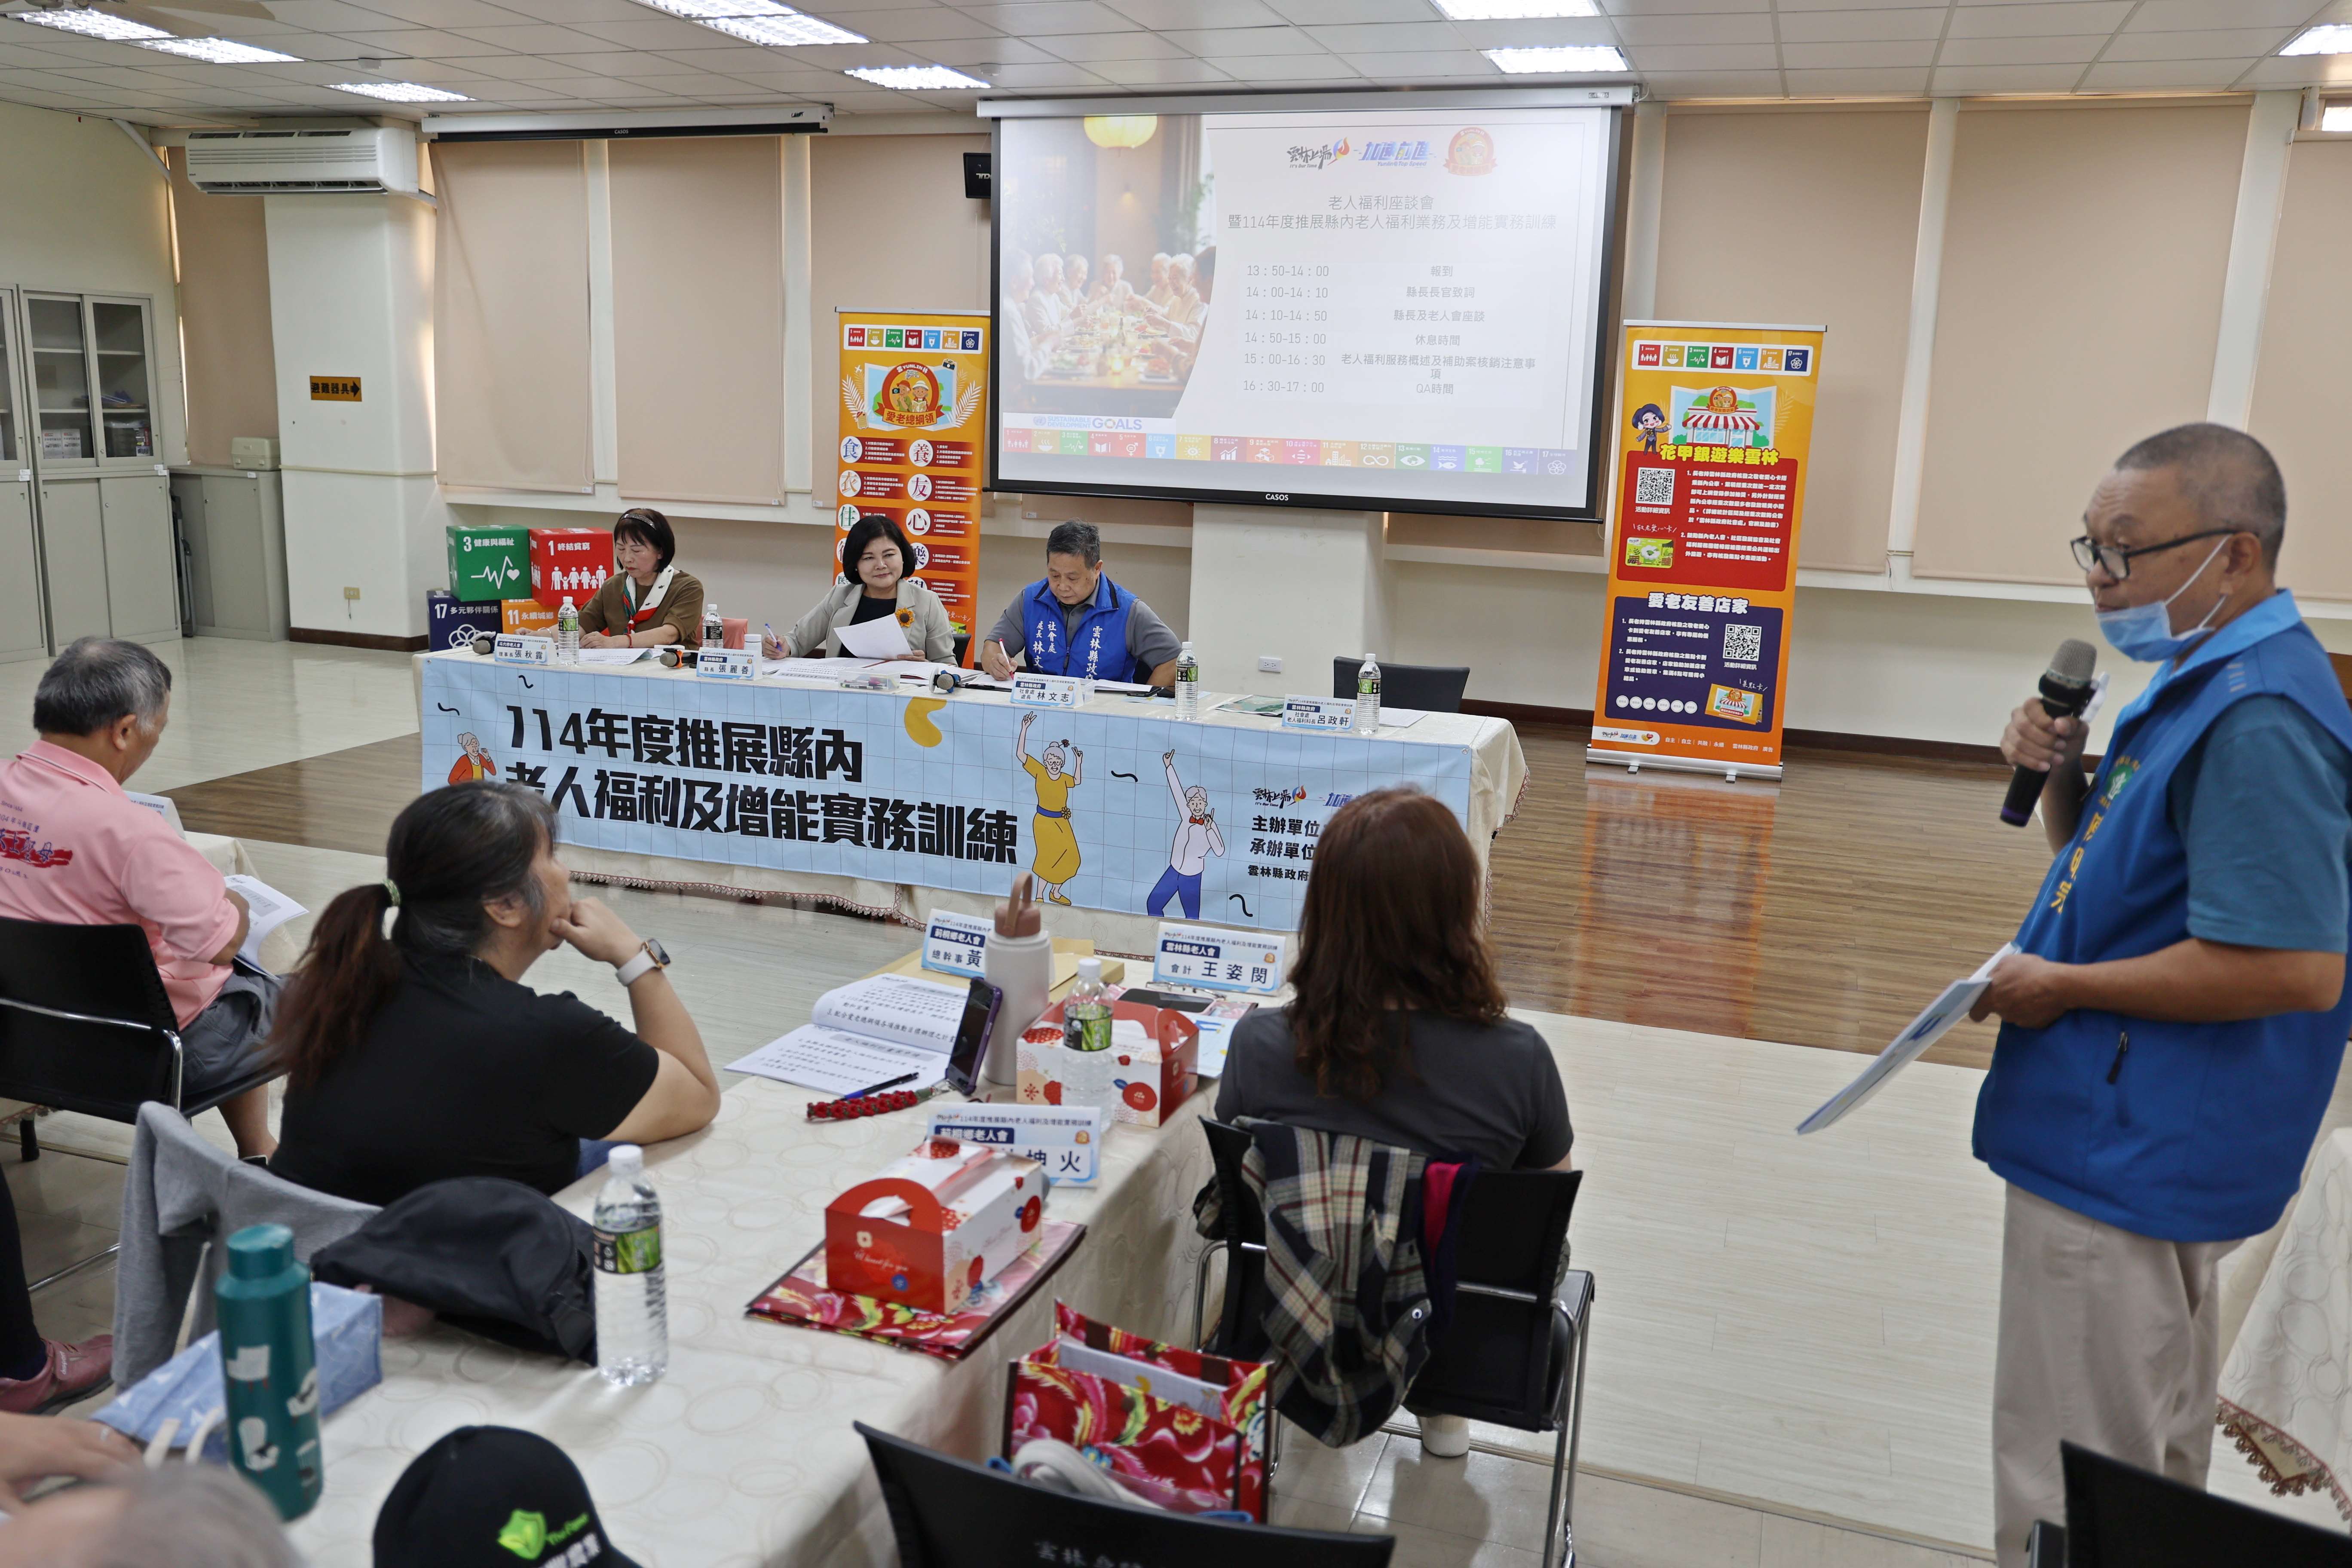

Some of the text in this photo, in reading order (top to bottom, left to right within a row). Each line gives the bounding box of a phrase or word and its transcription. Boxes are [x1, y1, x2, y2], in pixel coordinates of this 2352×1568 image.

[1328, 196, 1434, 210] 老人福利座談會
[1228, 214, 1557, 230] 暨114年度推展縣內老人福利業務及增能實務訓練
[1430, 266, 1453, 277] 報到
[1406, 287, 1475, 299] 縣長長官致詞
[1393, 309, 1485, 323] 縣長及老人會座談
[1415, 334, 1461, 346] 休息時間
[1341, 354, 1536, 369] 老人福利服務概述及補助案核銷注意事
[1430, 368, 1441, 380] 項
[312, 383, 349, 394] 避難器具
[1416, 383, 1454, 395] QA時間
[886, 411, 934, 425] 愛老總綱領
[1092, 418, 1142, 430] GOALS
[843, 439, 859, 459] 食
[914, 444, 930, 463] 養
[1660, 444, 1779, 466] 花甲銀遊樂雲林
[841, 473, 859, 494] 衣
[911, 477, 928, 498] 友
[907, 514, 927, 531] 心
[463, 536, 514, 552] 3 健康與福祉
[548, 540, 590, 556] 1 終結貧窮
[435, 603, 498, 619] 17 多元夥伴關係
[1648, 592, 1748, 614] 愛老友善店家
[507, 609, 554, 625] 11 永續城鄉
[1036, 621, 1044, 638] 處長
[1047, 621, 1057, 653] 社會處
[515, 650, 542, 659] 張秋露
[719, 665, 749, 674] 張麗善
[1724, 662, 1757, 670] 活動詳細資訊
[1037, 691, 1069, 702] 林文志
[1317, 715, 1349, 726] 呂政軒
[506, 705, 863, 782] 114年度推展縣內
[1253, 788, 1291, 809] 雲林上場
[1252, 815, 1320, 838] 主辦單位
[1250, 838, 1317, 860] 承辦單位
[1248, 865, 1309, 881] 雲林縣政府
[935, 928, 981, 945] 莿桐鄉老人會
[1166, 942, 1216, 957] 雲林縣老人會
[932, 949, 981, 967] 總幹事 黃
[1171, 962, 1267, 984] 會計 王姿閔
